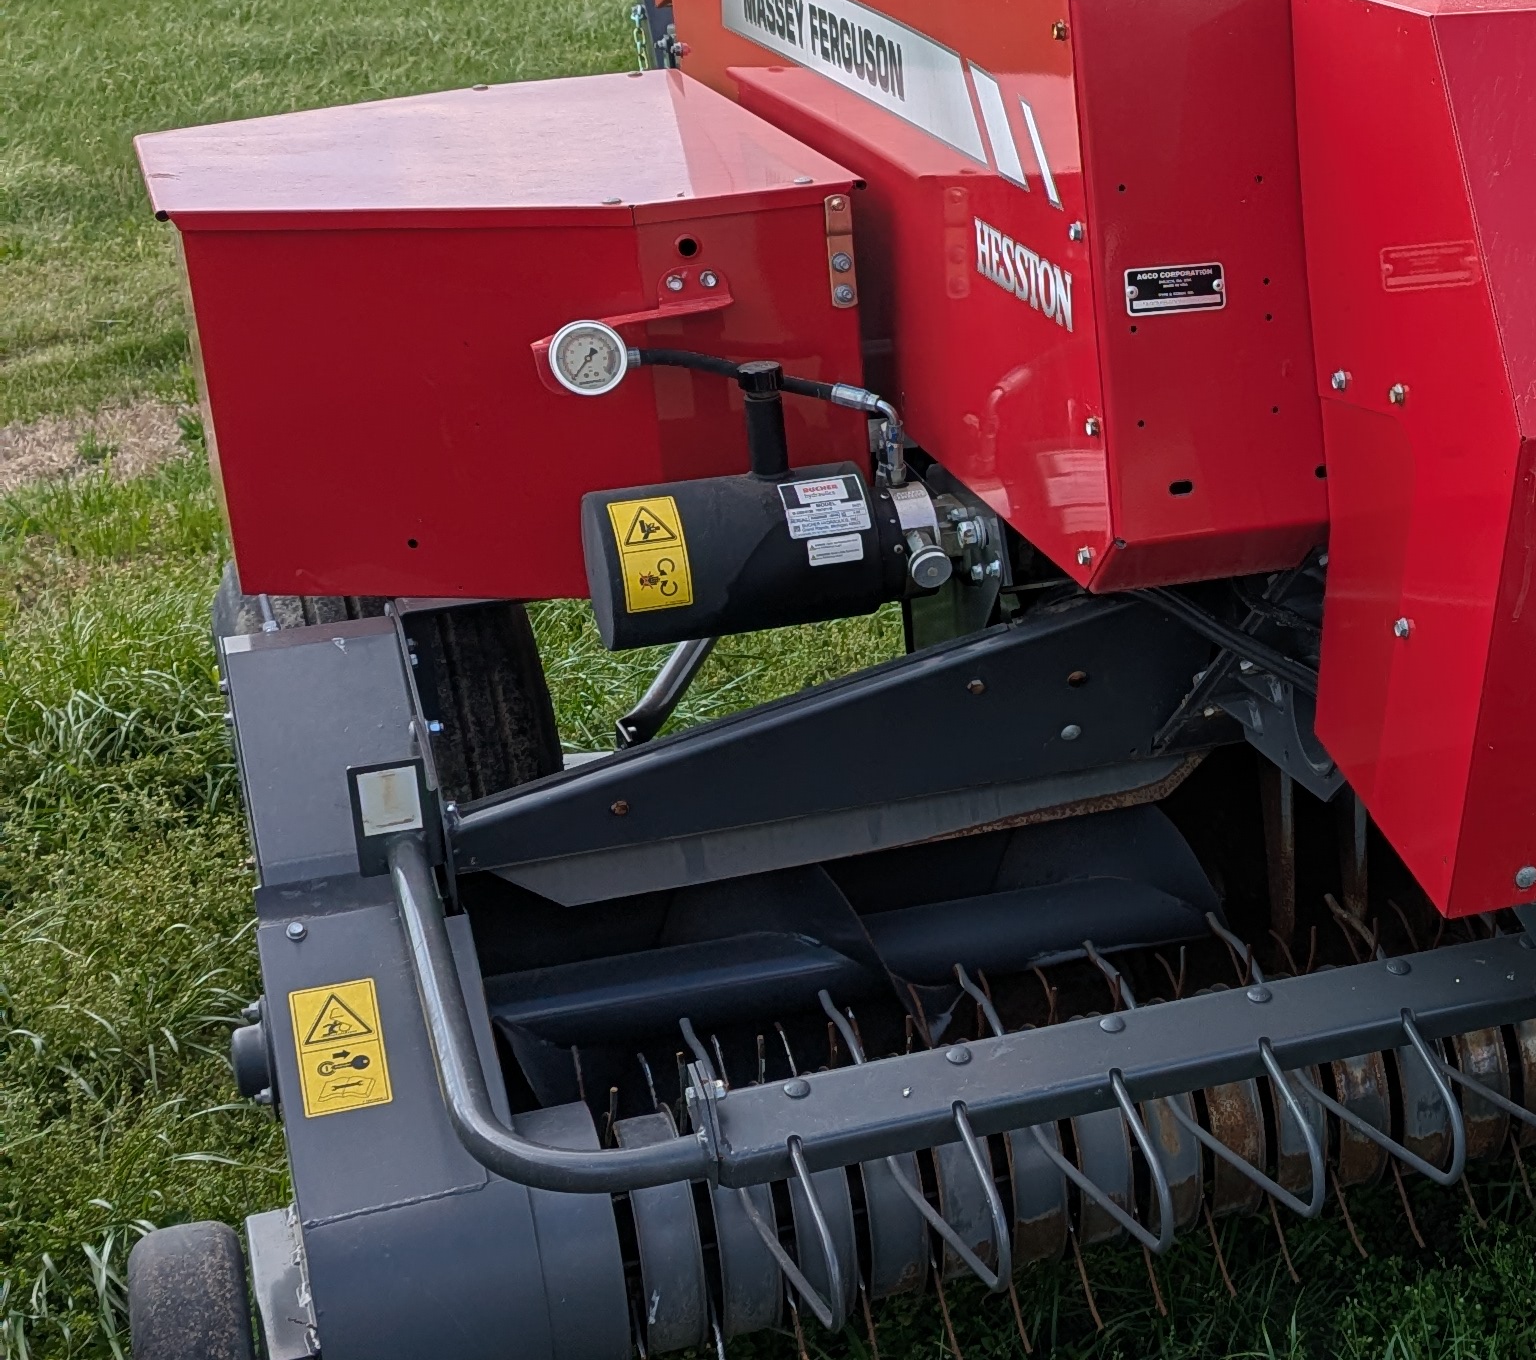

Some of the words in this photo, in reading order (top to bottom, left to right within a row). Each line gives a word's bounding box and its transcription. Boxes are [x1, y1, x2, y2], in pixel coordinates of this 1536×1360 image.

[808, 2, 905, 102] FERGUSON
[974, 216, 1073, 332] HESSTON
[1136, 272, 1158, 281] AGCO
[1160, 268, 1213, 279] CORPORATION
[802, 484, 838, 493] BUCHER
